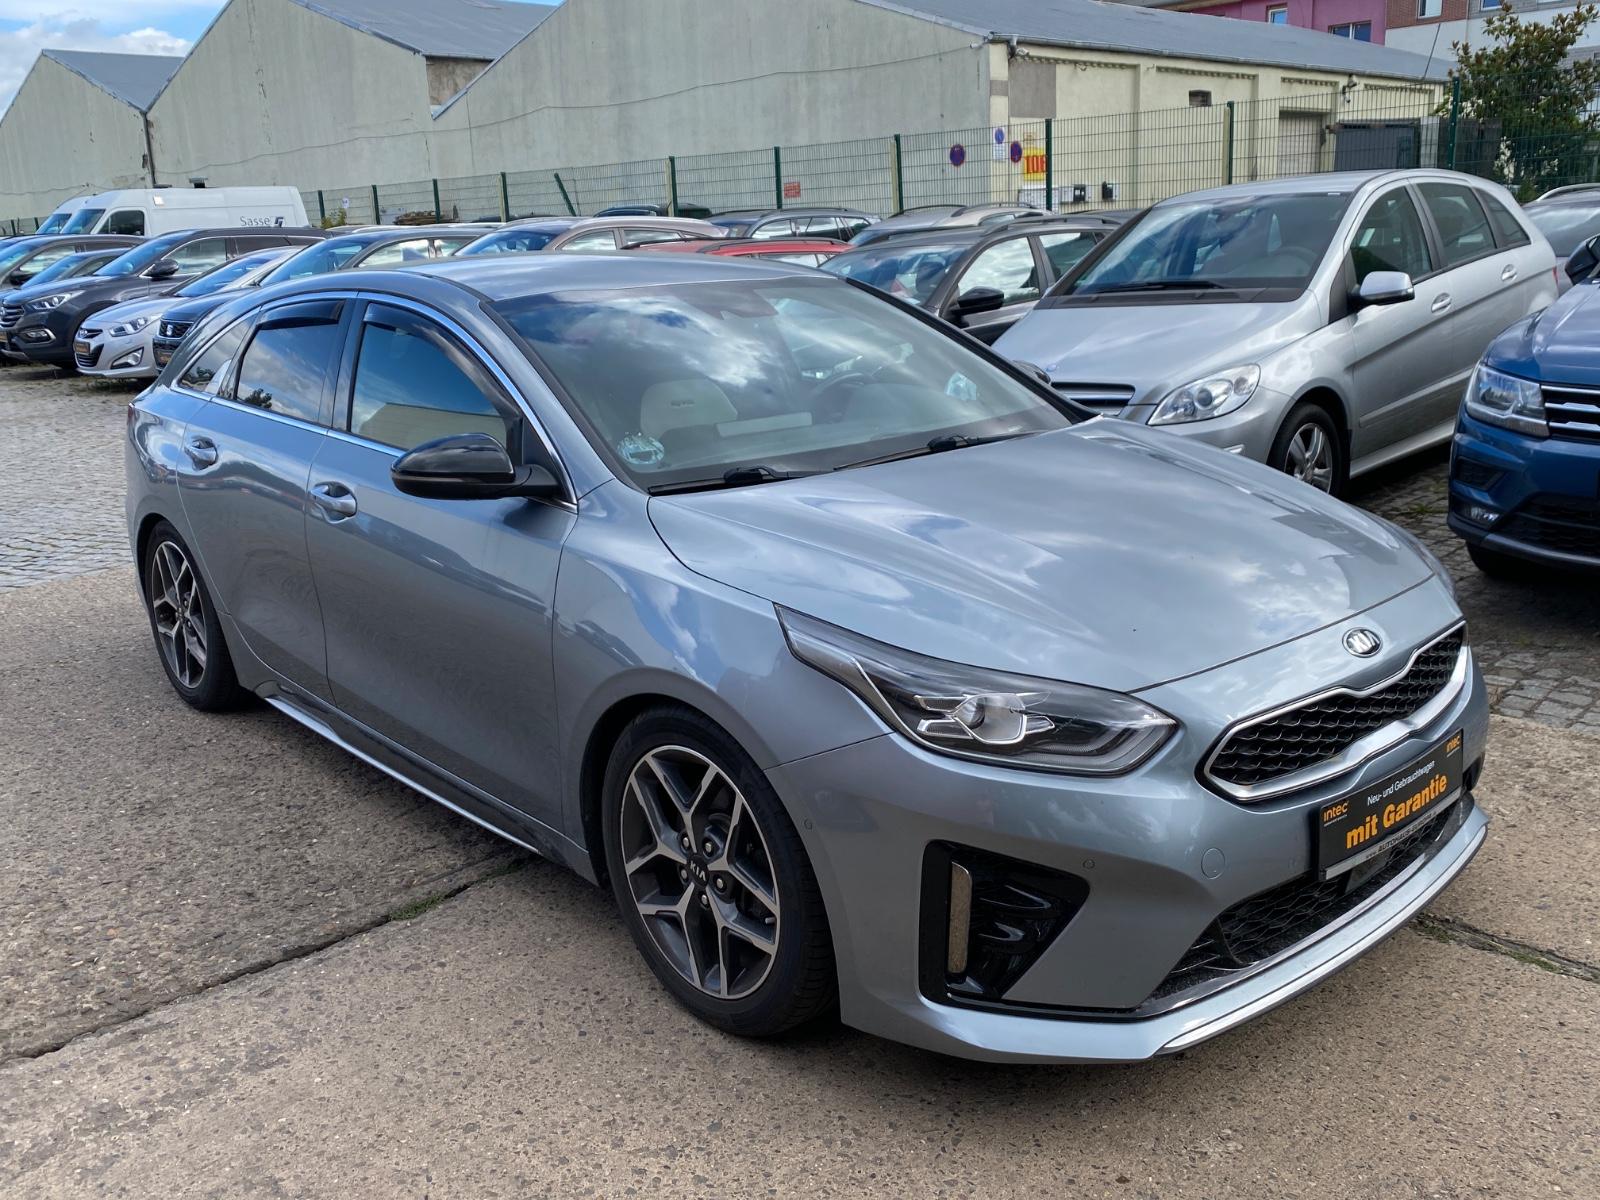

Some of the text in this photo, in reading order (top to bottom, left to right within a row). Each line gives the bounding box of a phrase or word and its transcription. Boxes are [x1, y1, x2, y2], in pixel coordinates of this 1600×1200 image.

[240, 216, 270, 226] Sasse
[1367, 795, 1382, 806] Neu-
[1382, 784, 1394, 798] und
[1346, 814, 1378, 849] mit
[1382, 774, 1447, 828] Garantie
[690, 860, 706, 881] KIA
